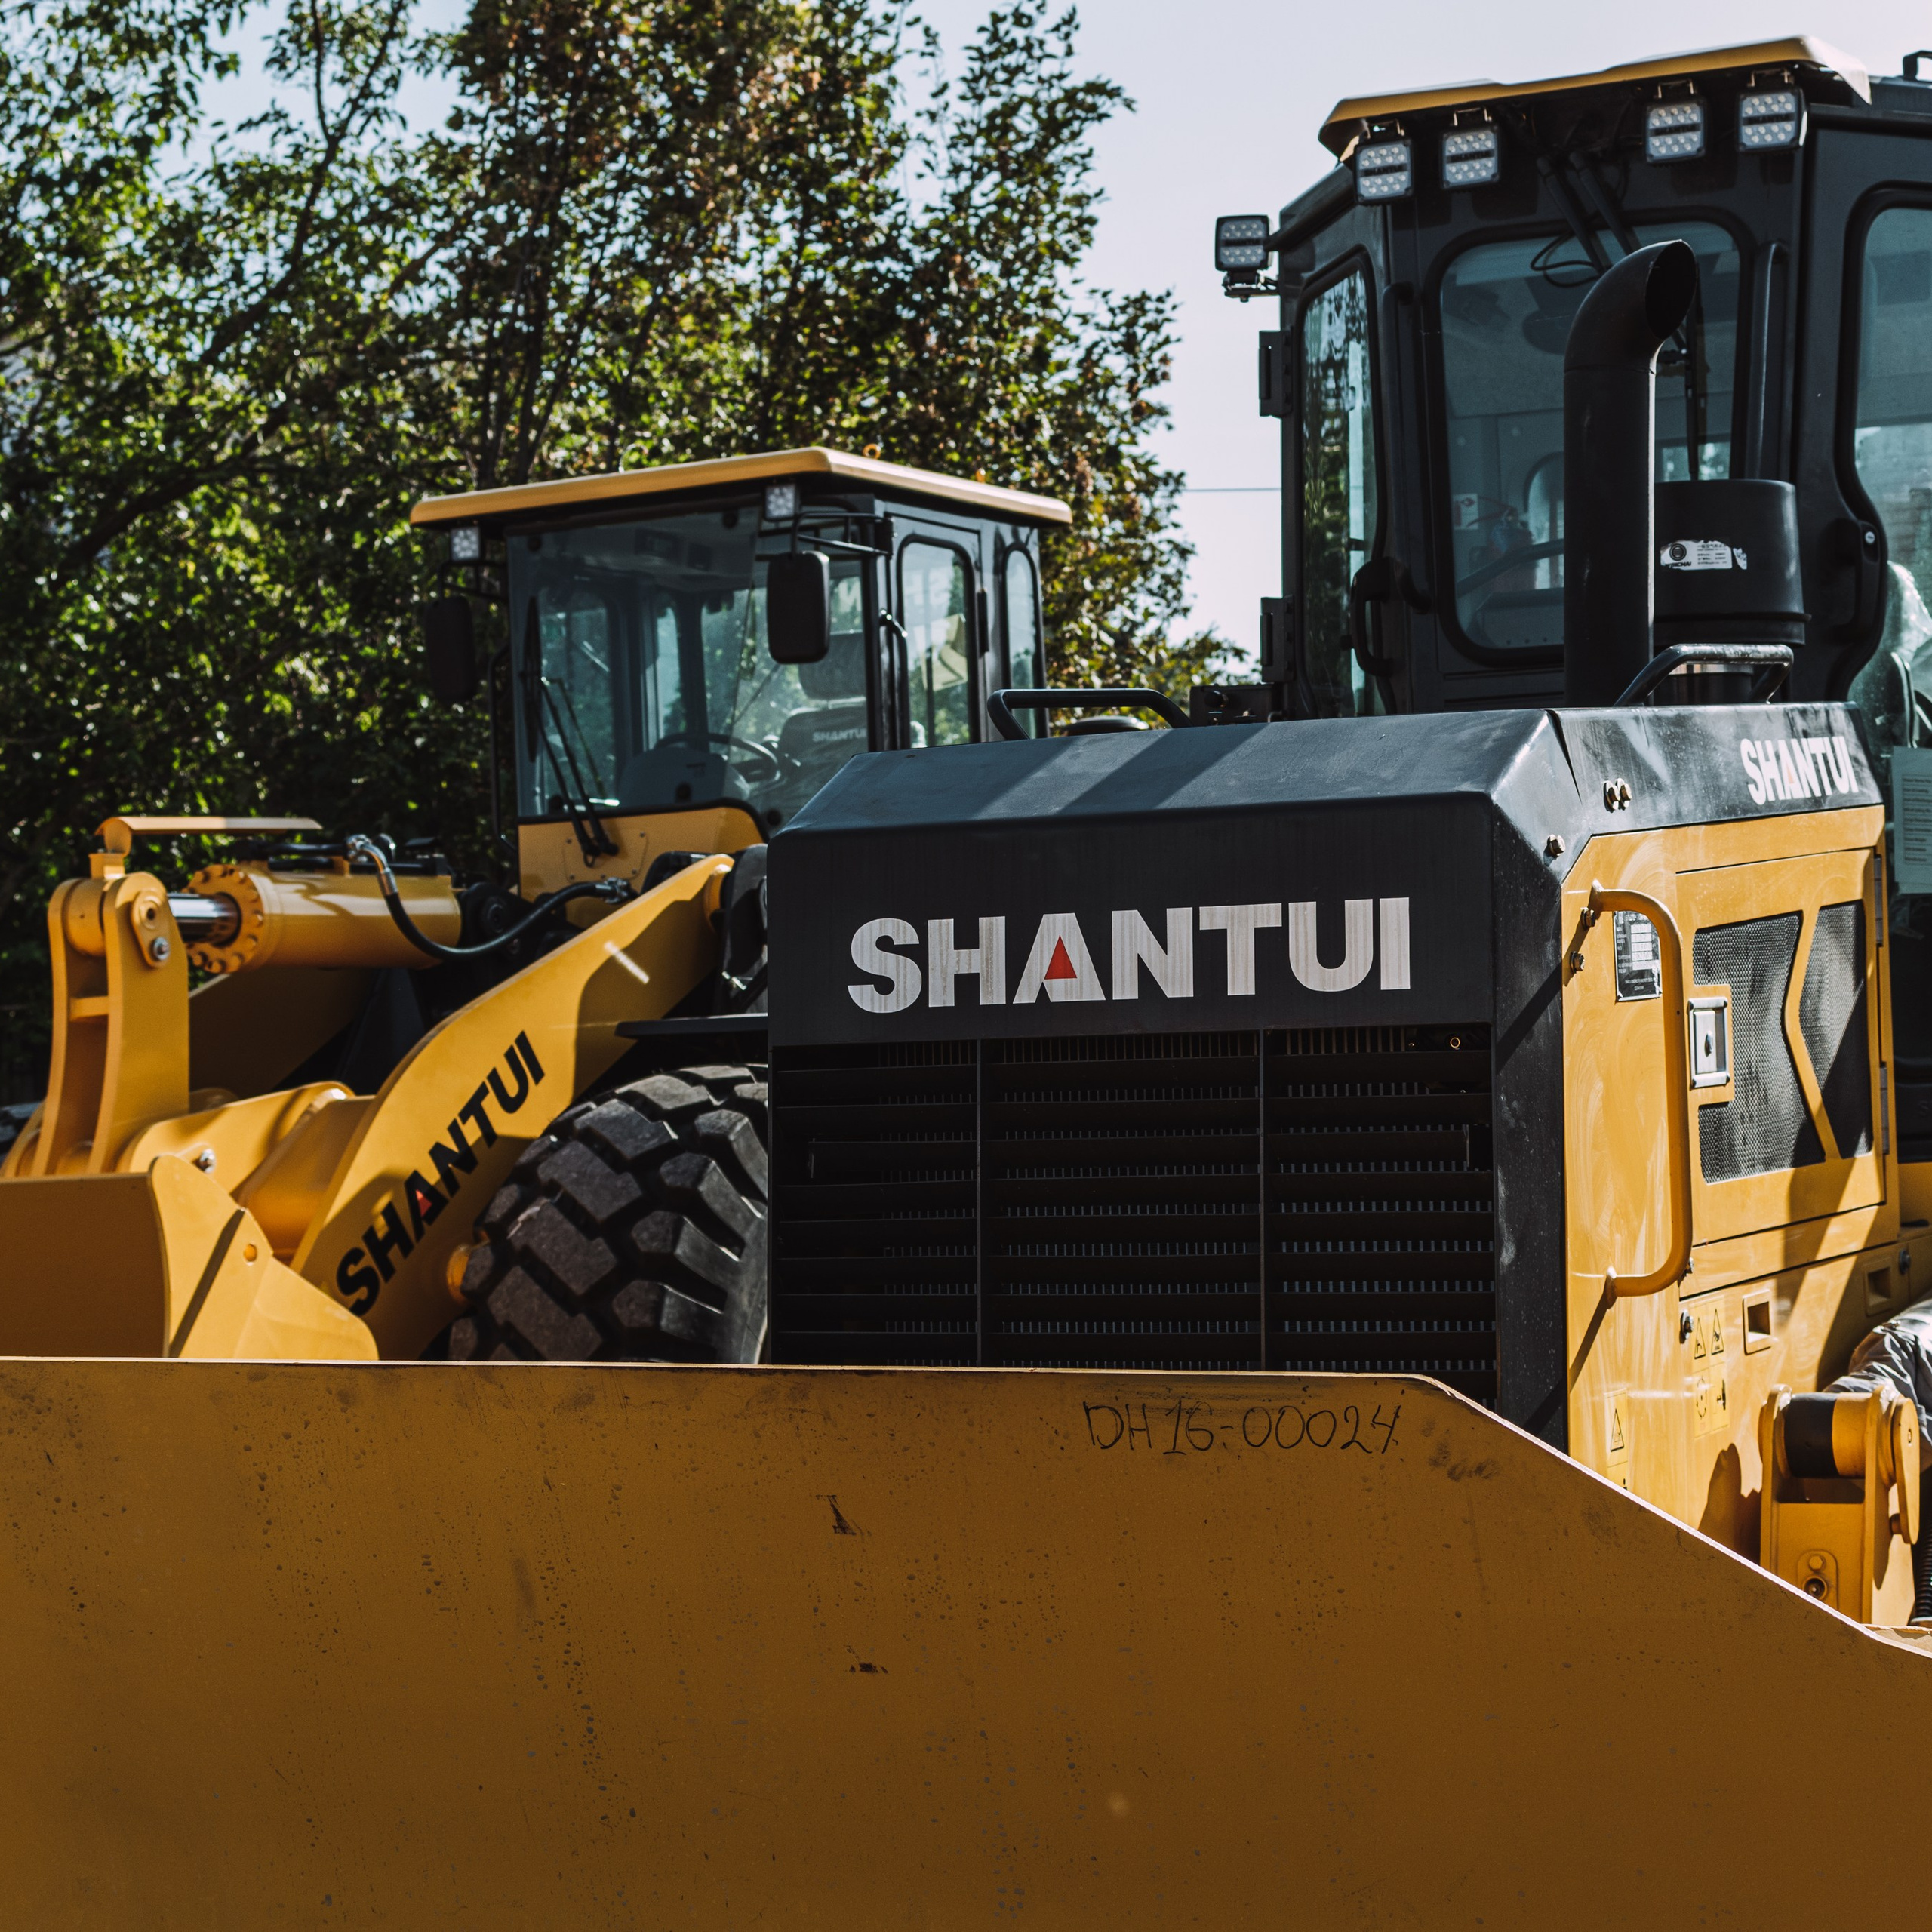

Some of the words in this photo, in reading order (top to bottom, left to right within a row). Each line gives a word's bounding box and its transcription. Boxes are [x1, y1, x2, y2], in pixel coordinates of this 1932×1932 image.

[1740, 736, 1859, 805] SHANTUI
[847, 897, 1411, 1014] SHANTUI
[336, 1030, 545, 1316] SHANTUI
